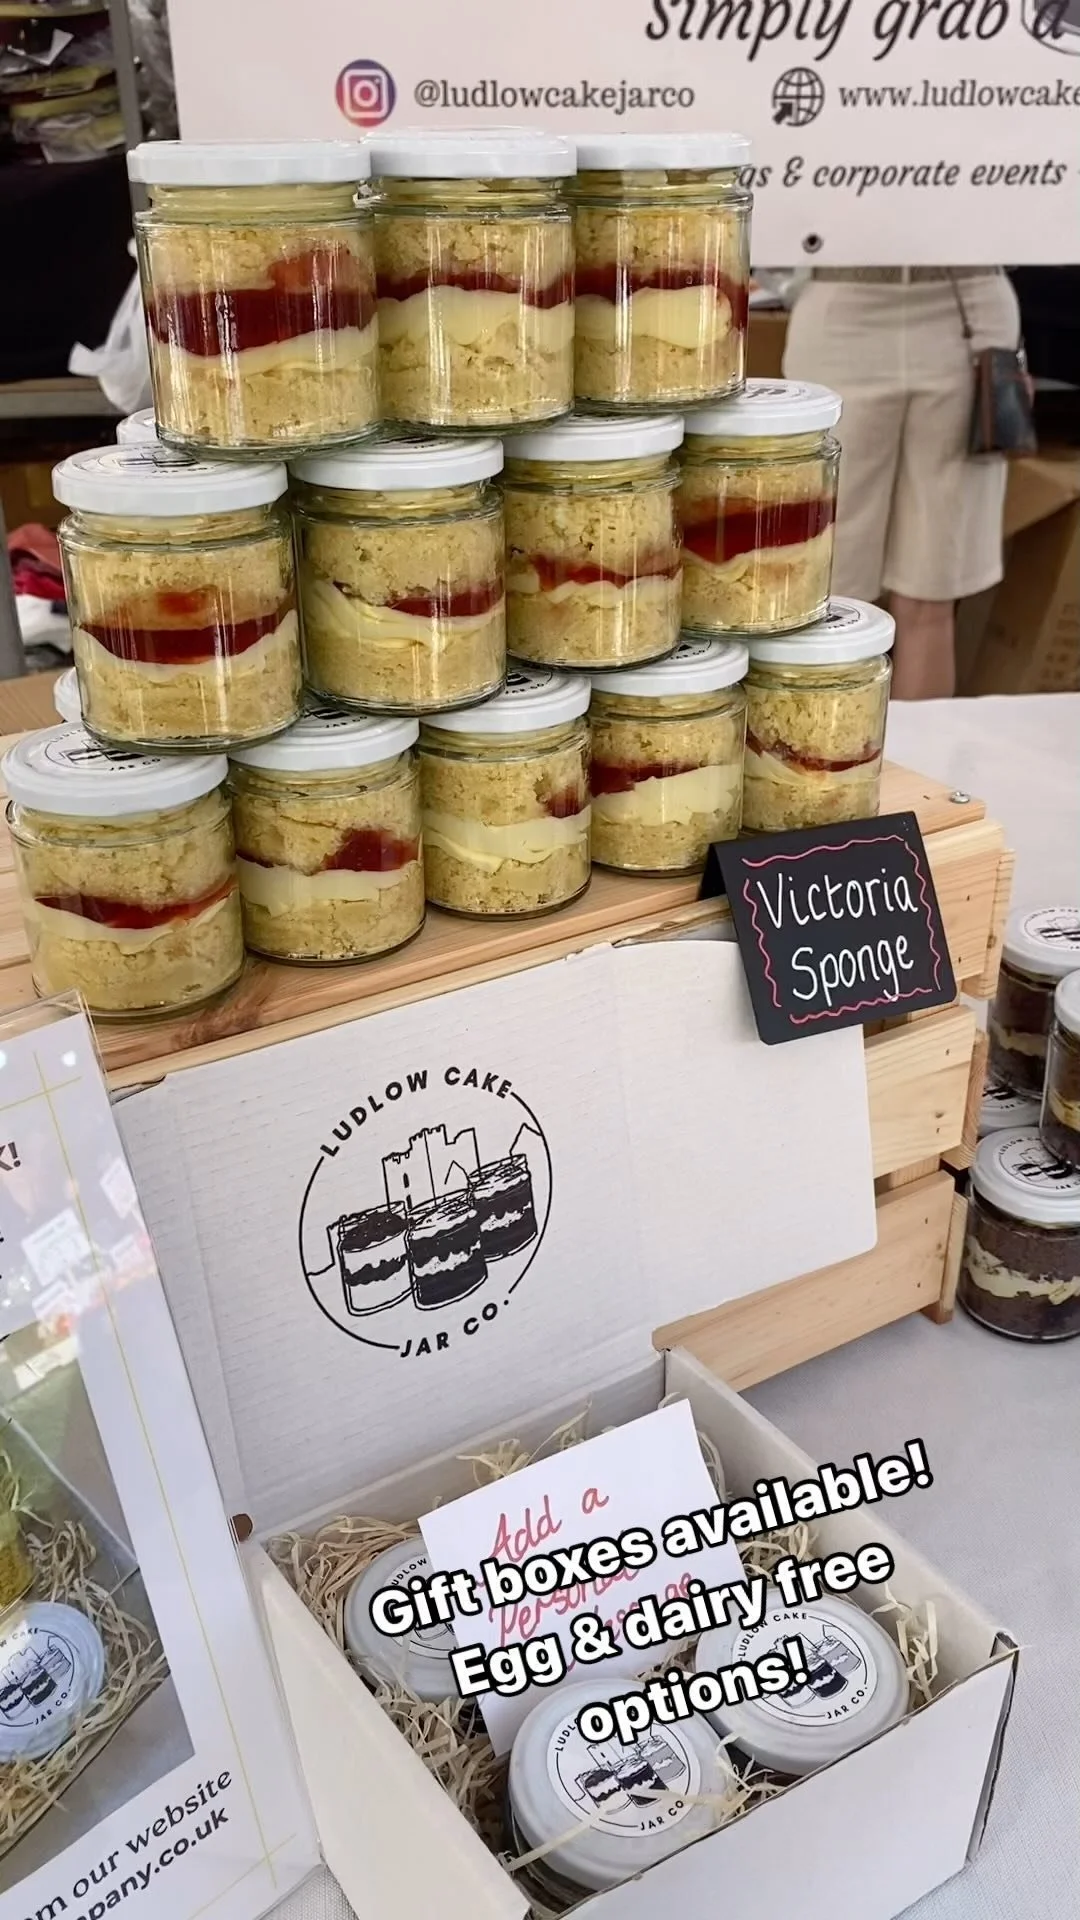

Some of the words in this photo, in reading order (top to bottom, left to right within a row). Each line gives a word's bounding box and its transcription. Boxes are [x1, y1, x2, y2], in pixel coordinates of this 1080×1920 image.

[873, 0, 1010, 62] grab
[414, 79, 695, 115] @ludlowcakejarco
[783, 156, 804, 187] &
[813, 160, 960, 196] corporate
[970, 158, 1068, 186] events
[756, 868, 918, 929] Victoria
[790, 935, 914, 1006] Sponge
[319, 1069, 428, 1157] LUDLOW
[444, 1066, 513, 1099] CAKE
[400, 1331, 450, 1358] JAR
[463, 1299, 510, 1336] CO.
[489, 1494, 562, 1562] Add
[581, 1487, 610, 1515] a
[391, 1557, 428, 1587] UDLOW
[772, 1611, 808, 1623] CAKE
[554, 1720, 579, 1752] LUDL
[826, 1704, 850, 1719] JAR
[72, 1849, 120, 1899] our
[125, 1770, 233, 1856] website
[640, 1815, 666, 1831] JAR
